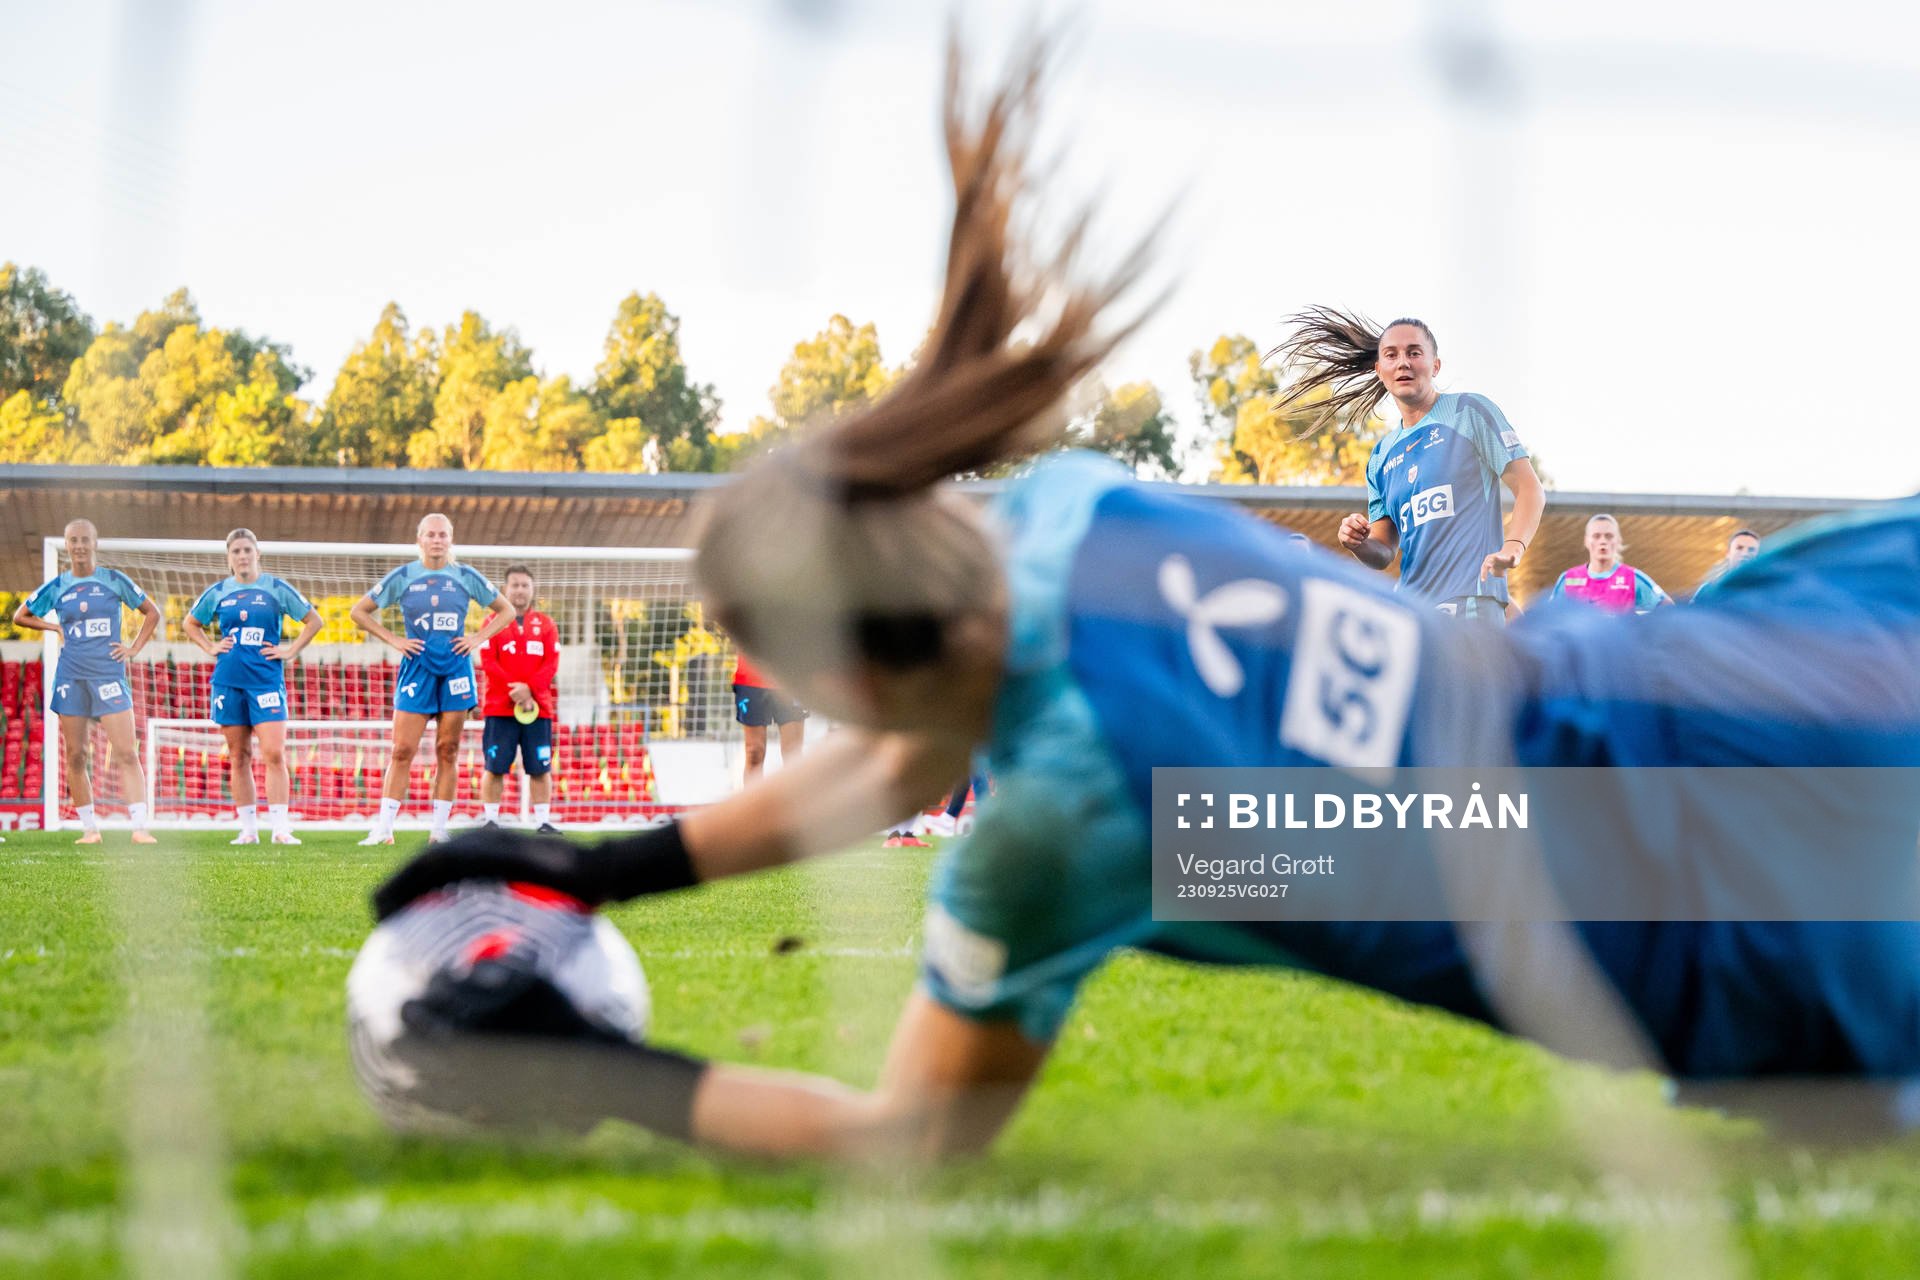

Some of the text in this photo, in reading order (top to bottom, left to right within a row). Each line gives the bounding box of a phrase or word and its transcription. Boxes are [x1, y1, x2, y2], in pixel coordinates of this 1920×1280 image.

[1417, 492, 1447, 518] 5G
[89, 622, 107, 633] 5G
[436, 617, 455, 627] 5G
[245, 632, 261, 642] 5G
[1316, 607, 1389, 747] 5G
[102, 685, 119, 697] 5G
[452, 682, 467, 692] 5G
